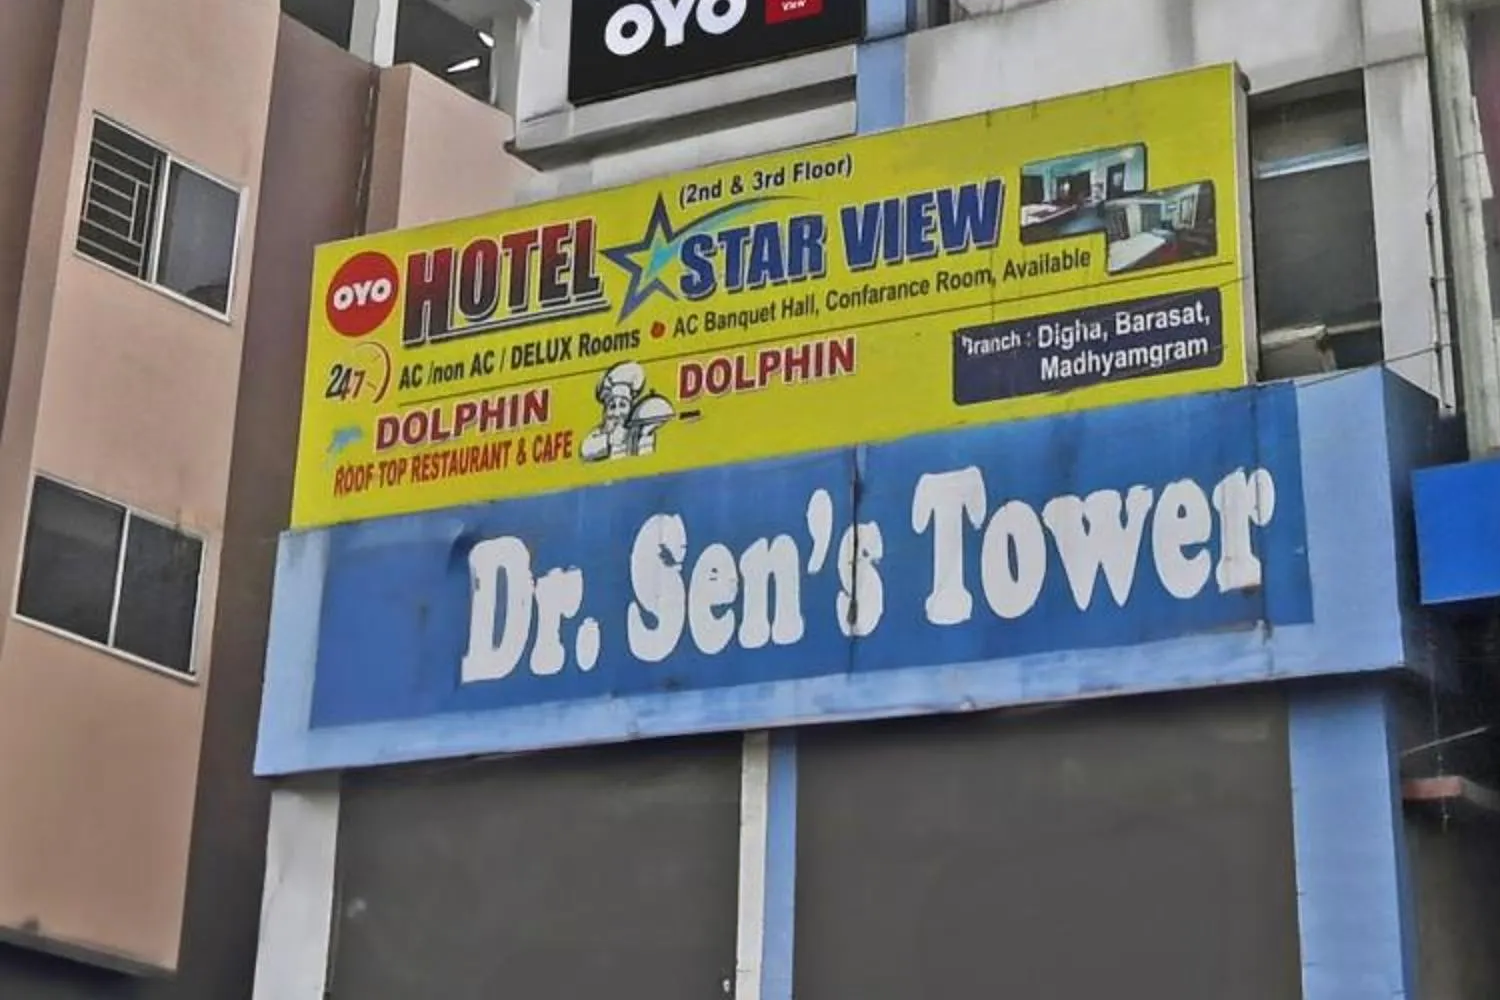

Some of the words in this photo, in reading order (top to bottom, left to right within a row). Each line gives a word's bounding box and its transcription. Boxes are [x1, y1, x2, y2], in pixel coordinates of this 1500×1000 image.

[679, 180, 722, 209] (2nd
[730, 175, 744, 194] &
[753, 168, 785, 191] 3rd
[793, 154, 853, 181] Floor)
[333, 278, 392, 310] OYO
[402, 217, 604, 348] HOTEL
[680, 214, 828, 301] STAR
[841, 178, 1005, 272] VIEW
[673, 314, 699, 338] AC
[704, 303, 776, 331] Banquet
[781, 292, 819, 319] Hall,
[826, 276, 930, 312] Confarance
[936, 267, 996, 289] Room,
[1003, 248, 1091, 281] Available
[1038, 318, 1108, 350] Digha,
[1115, 301, 1211, 336] Barasat,
[399, 363, 423, 390] AC
[470, 350, 495, 377] AC
[511, 336, 573, 369] DELUX
[579, 329, 641, 358] Rooms
[678, 337, 856, 400] DOLPHIN
[1041, 337, 1209, 380] Madhyamgram
[376, 388, 550, 451] DOLPHIN
[334, 464, 373, 497] ROOF
[379, 460, 407, 488] TOP
[410, 438, 511, 483] RESTAURANT
[517, 438, 527, 466] &
[532, 430, 574, 462] CAFE
[461, 535, 600, 683] Dr.
[627, 489, 884, 662] Sen's
[912, 465, 1275, 625] Tower
